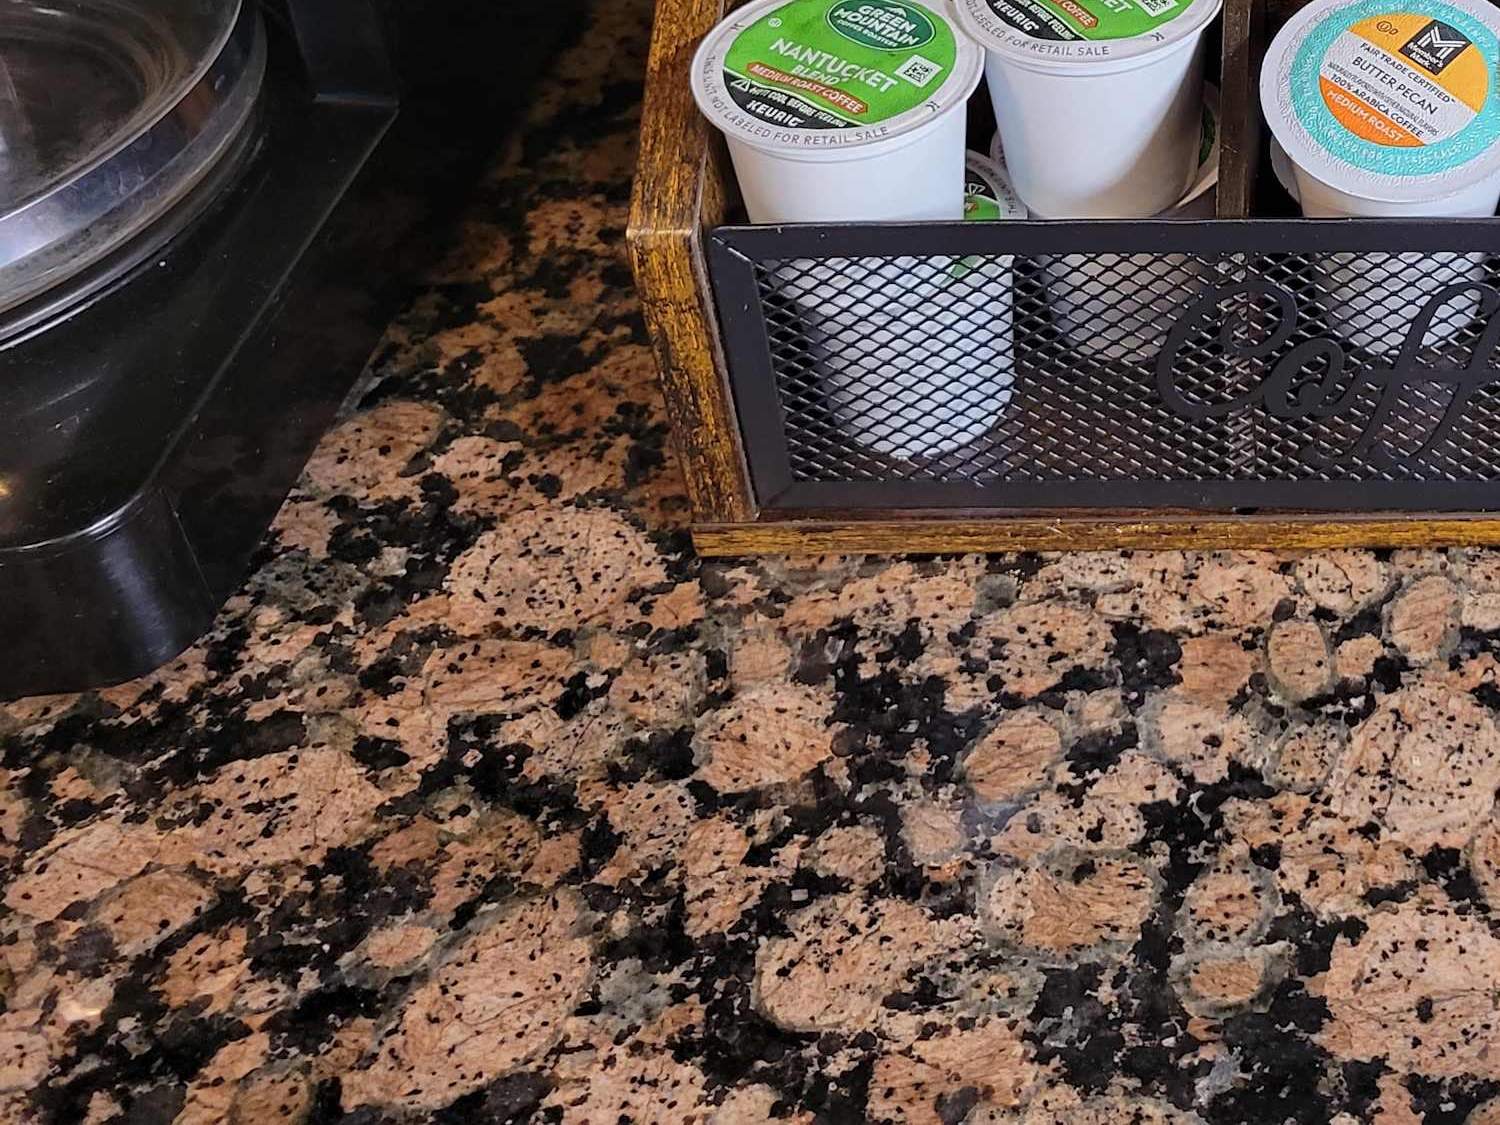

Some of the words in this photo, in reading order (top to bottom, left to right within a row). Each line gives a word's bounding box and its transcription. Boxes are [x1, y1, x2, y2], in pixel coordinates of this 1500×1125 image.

[833, 8, 920, 46] MOUNTAIN
[858, 5, 918, 33] GREEN
[993, 0, 1040, 32] KEURIG
[1061, 0, 1094, 27] COFFEE
[1007, 36, 1028, 49] FOR
[1031, 43, 1073, 56] RETAIL
[1077, 45, 1110, 57] SALE
[1360, 42, 1381, 57] FAIR
[1379, 53, 1410, 75] TRADE
[1406, 41, 1444, 68] Member's
[769, 37, 898, 92] NANTUCKET
[791, 65, 840, 85] BLEND
[749, 64, 794, 86] MEDIUM
[792, 77, 824, 94] ROAST
[823, 88, 864, 114] COFFEE
[1352, 56, 1397, 89] BUTTER
[1397, 84, 1439, 115] PECAN
[746, 100, 805, 127] KEURIG
[1327, 90, 1369, 121] MEDIUM
[1368, 115, 1404, 142] ROAST
[1330, 73, 1354, 92] 100%
[1352, 88, 1390, 117] ARABICA
[1390, 112, 1425, 139] COFFEE
[724, 110, 771, 138] LABELED
[772, 131, 800, 146] FOR
[803, 134, 850, 146] RETAIL
[855, 125, 889, 142] SALE
